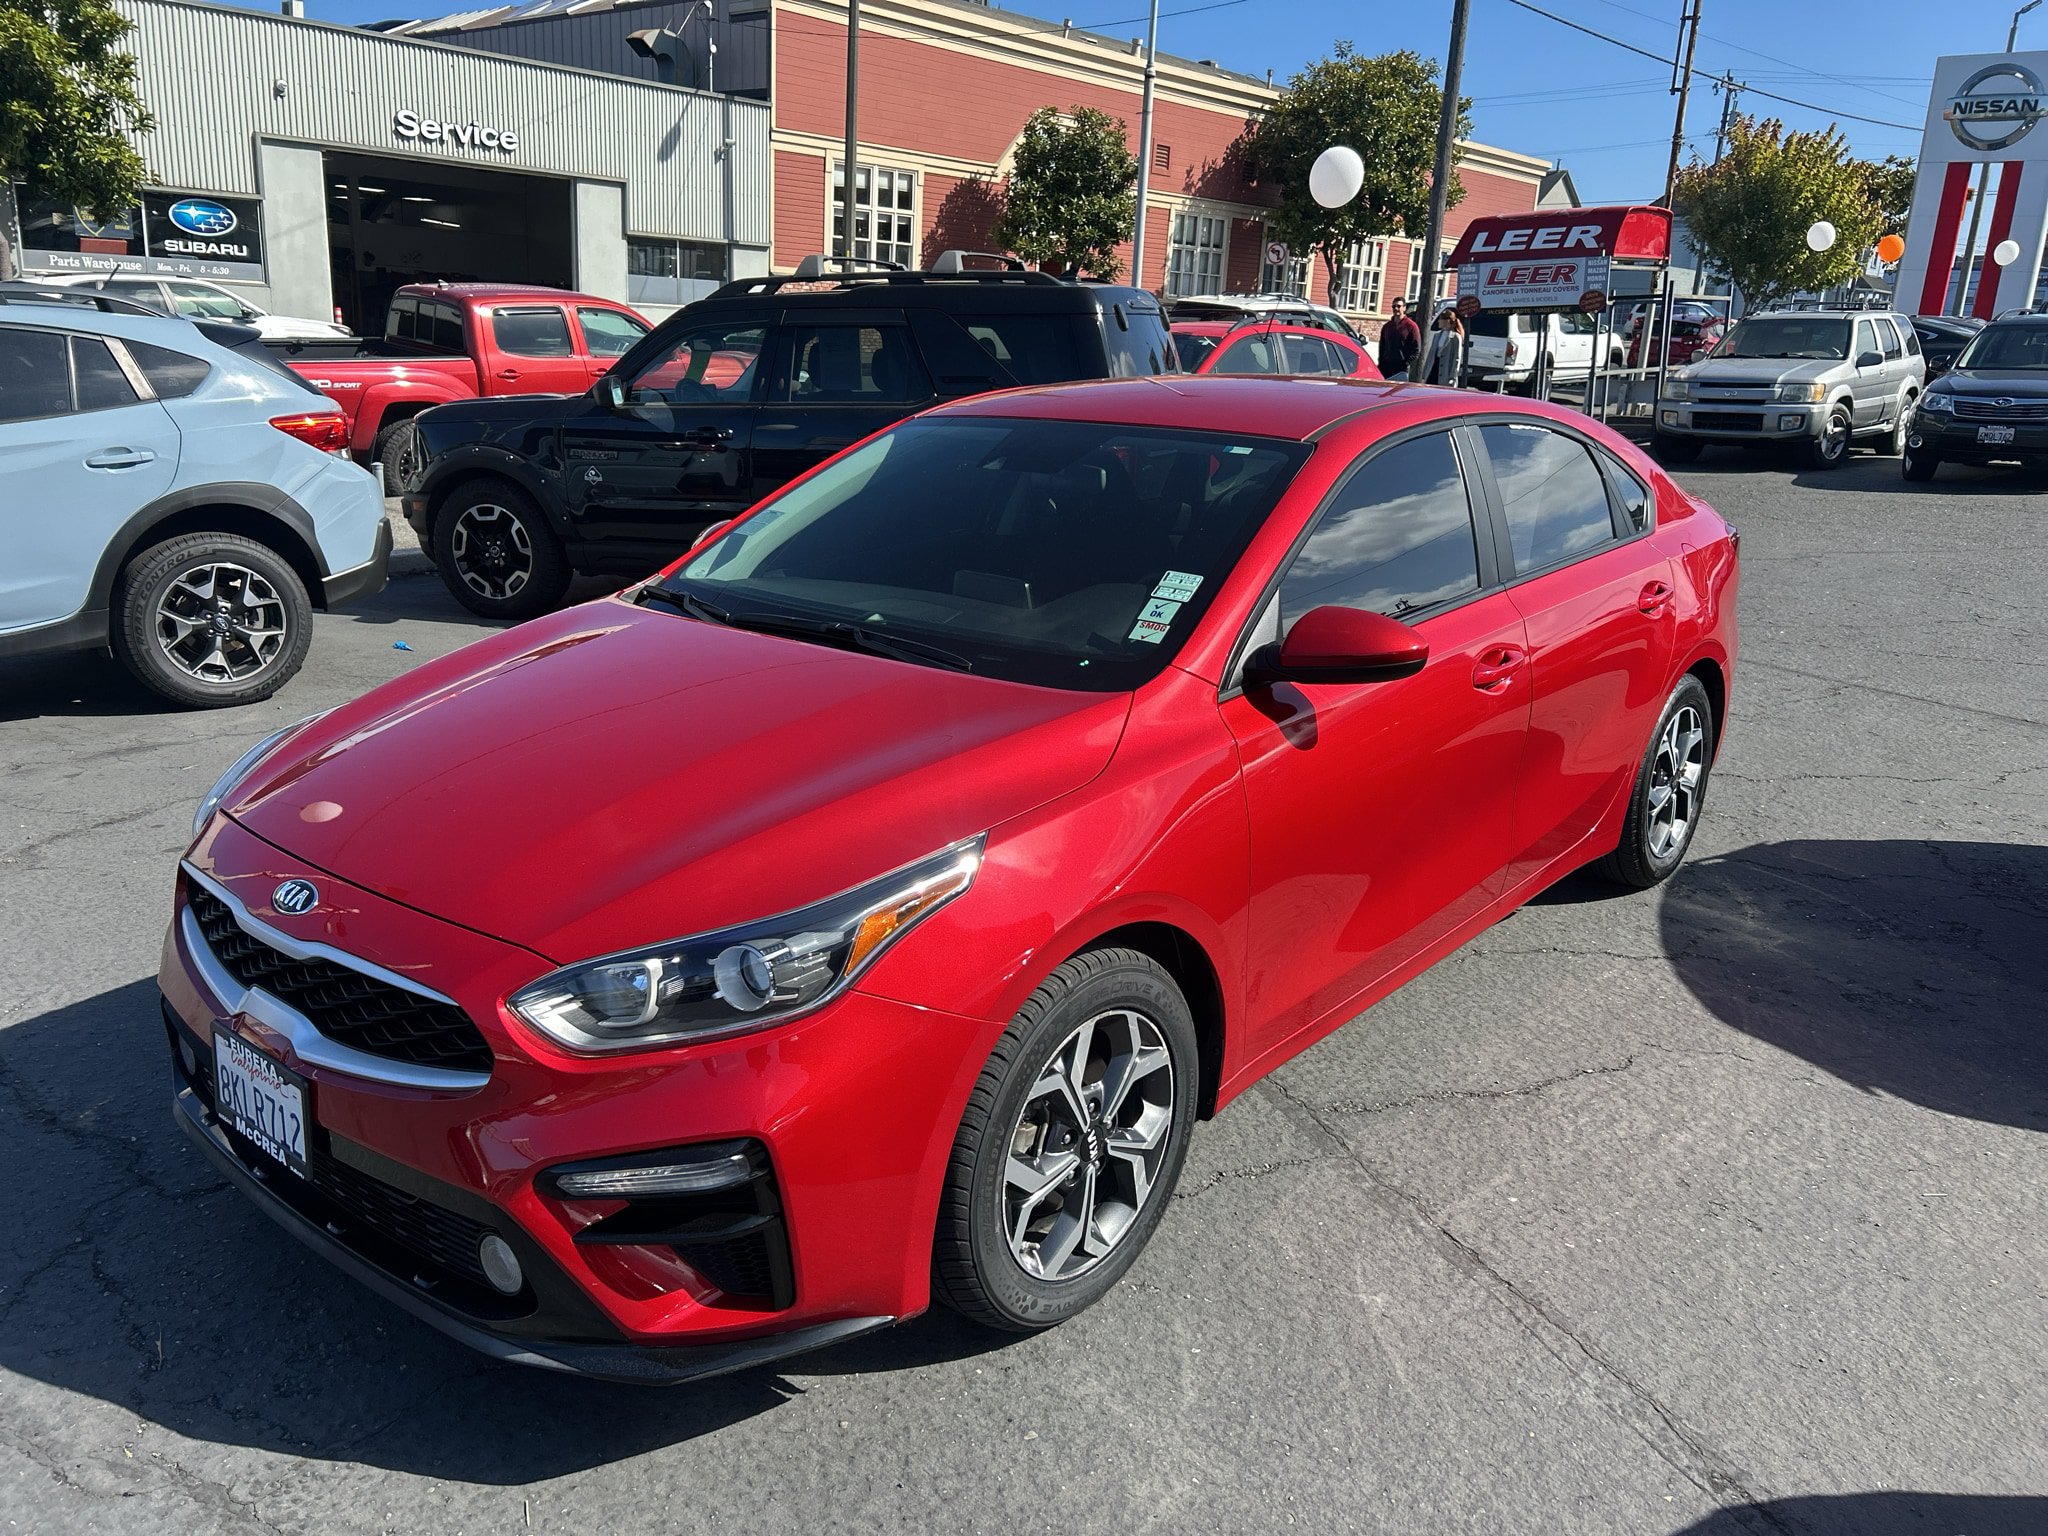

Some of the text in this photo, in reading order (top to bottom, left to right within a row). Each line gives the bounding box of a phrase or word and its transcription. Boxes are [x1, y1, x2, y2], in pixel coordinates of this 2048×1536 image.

[1953, 99, 2039, 115] NISSAN
[396, 109, 519, 150] Service
[164, 239, 248, 256] SUBARU
[1469, 225, 1602, 253] LEER
[49, 254, 142, 271] Parts Warehouse
[156, 262, 174, 272] Mon.
[179, 264, 192, 273] Fri.
[200, 265, 206, 273] 8
[212, 266, 230, 275] 5:30
[1485, 264, 1578, 287] LEER
[1521, 286, 1551, 294] TONNEAU
[1150, 610, 1164, 618] OK
[1139, 621, 1167, 632] SMOG
[276, 882, 310, 910] KIA
[230, 1037, 277, 1080] EUREKA
[220, 1064, 303, 1161] 8KLR712
[236, 1116, 287, 1166] McCREA
